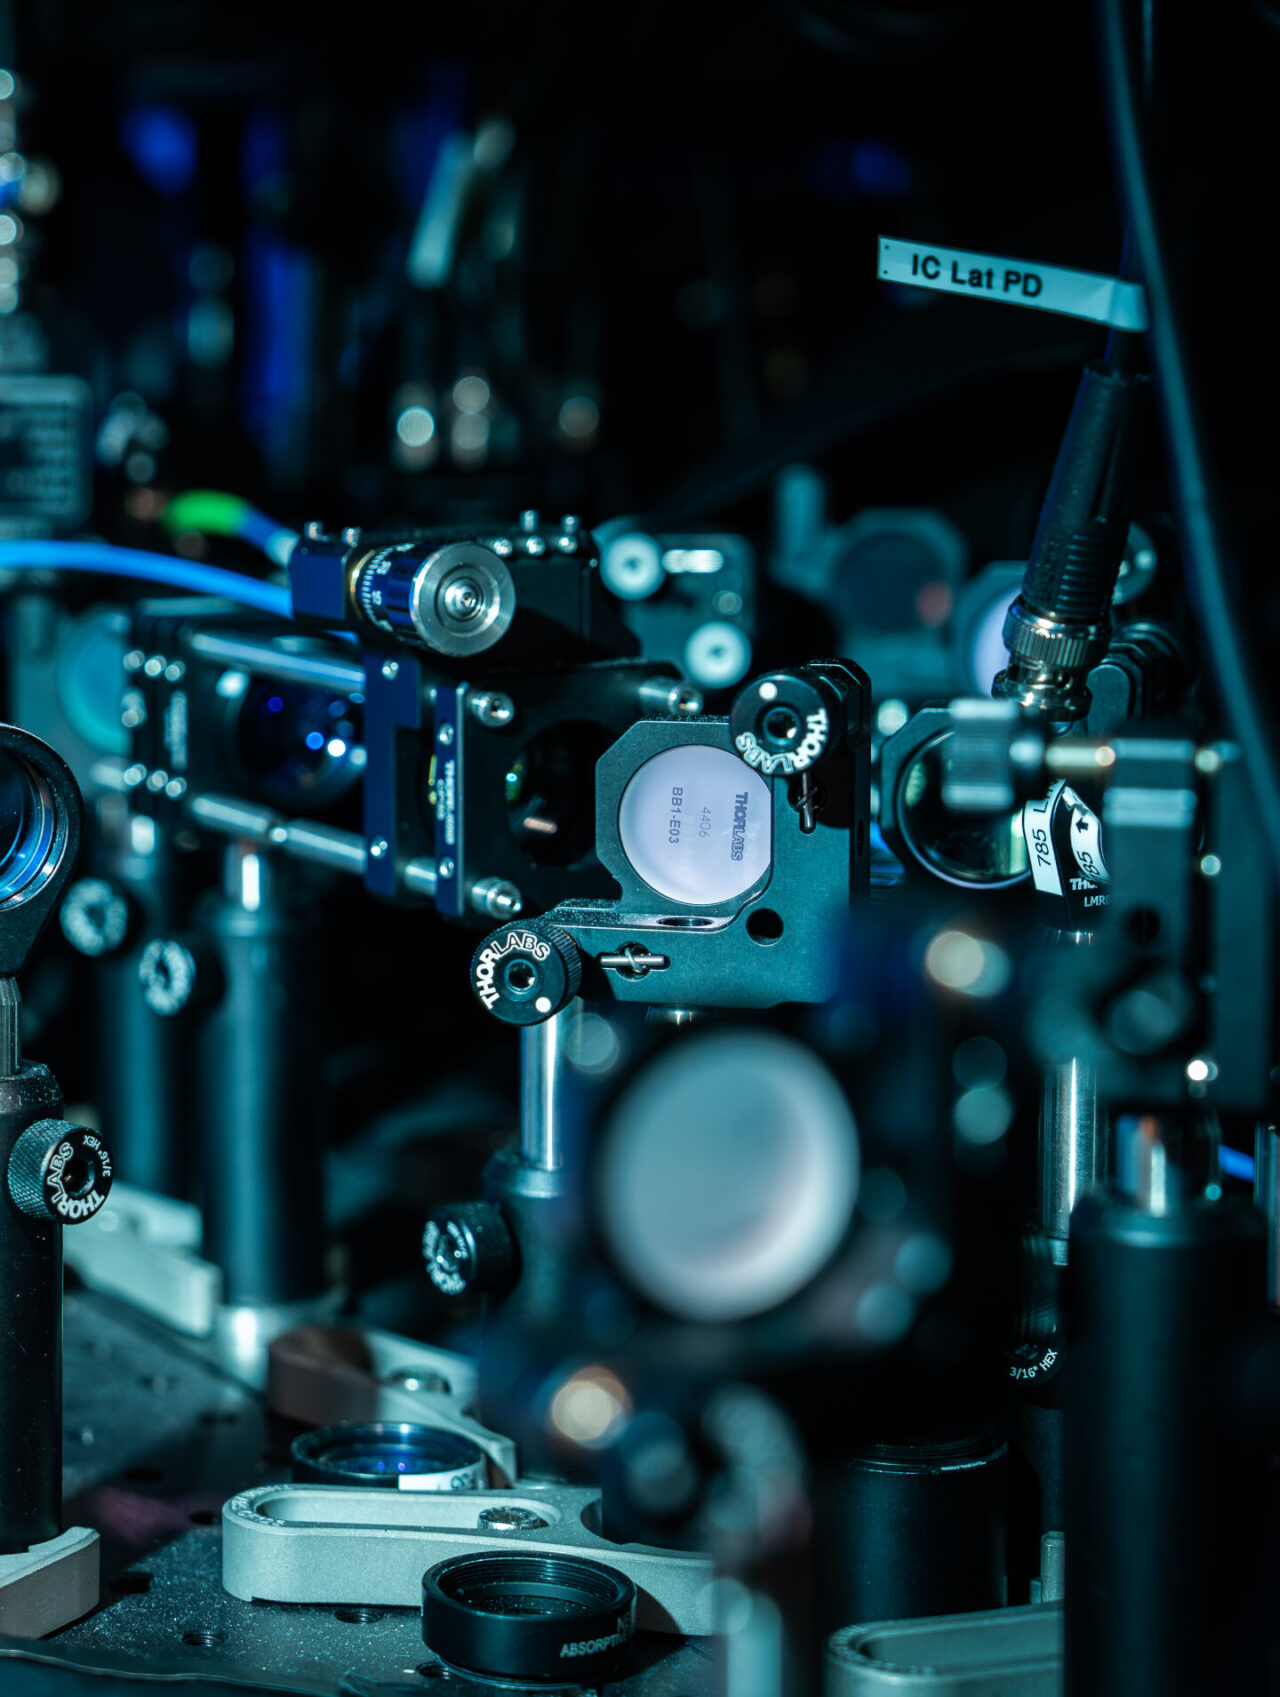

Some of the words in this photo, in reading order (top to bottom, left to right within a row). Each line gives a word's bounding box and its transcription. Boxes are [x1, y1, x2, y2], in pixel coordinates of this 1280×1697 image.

[912, 253, 940, 280] IC
[951, 260, 994, 289] Lat
[1003, 269, 1043, 298] PD
[735, 707, 828, 775] THORLABS
[668, 786, 684, 844] BB1-E03
[698, 806, 711, 838] 4406
[731, 791, 749, 862] THORLABS
[1032, 828, 1052, 867] 785
[475, 931, 552, 1011] THORLABS
[82, 1134, 102, 1151] HEX
[46, 1141, 105, 1219] THORLABS
[1039, 1347, 1058, 1372] HEX
